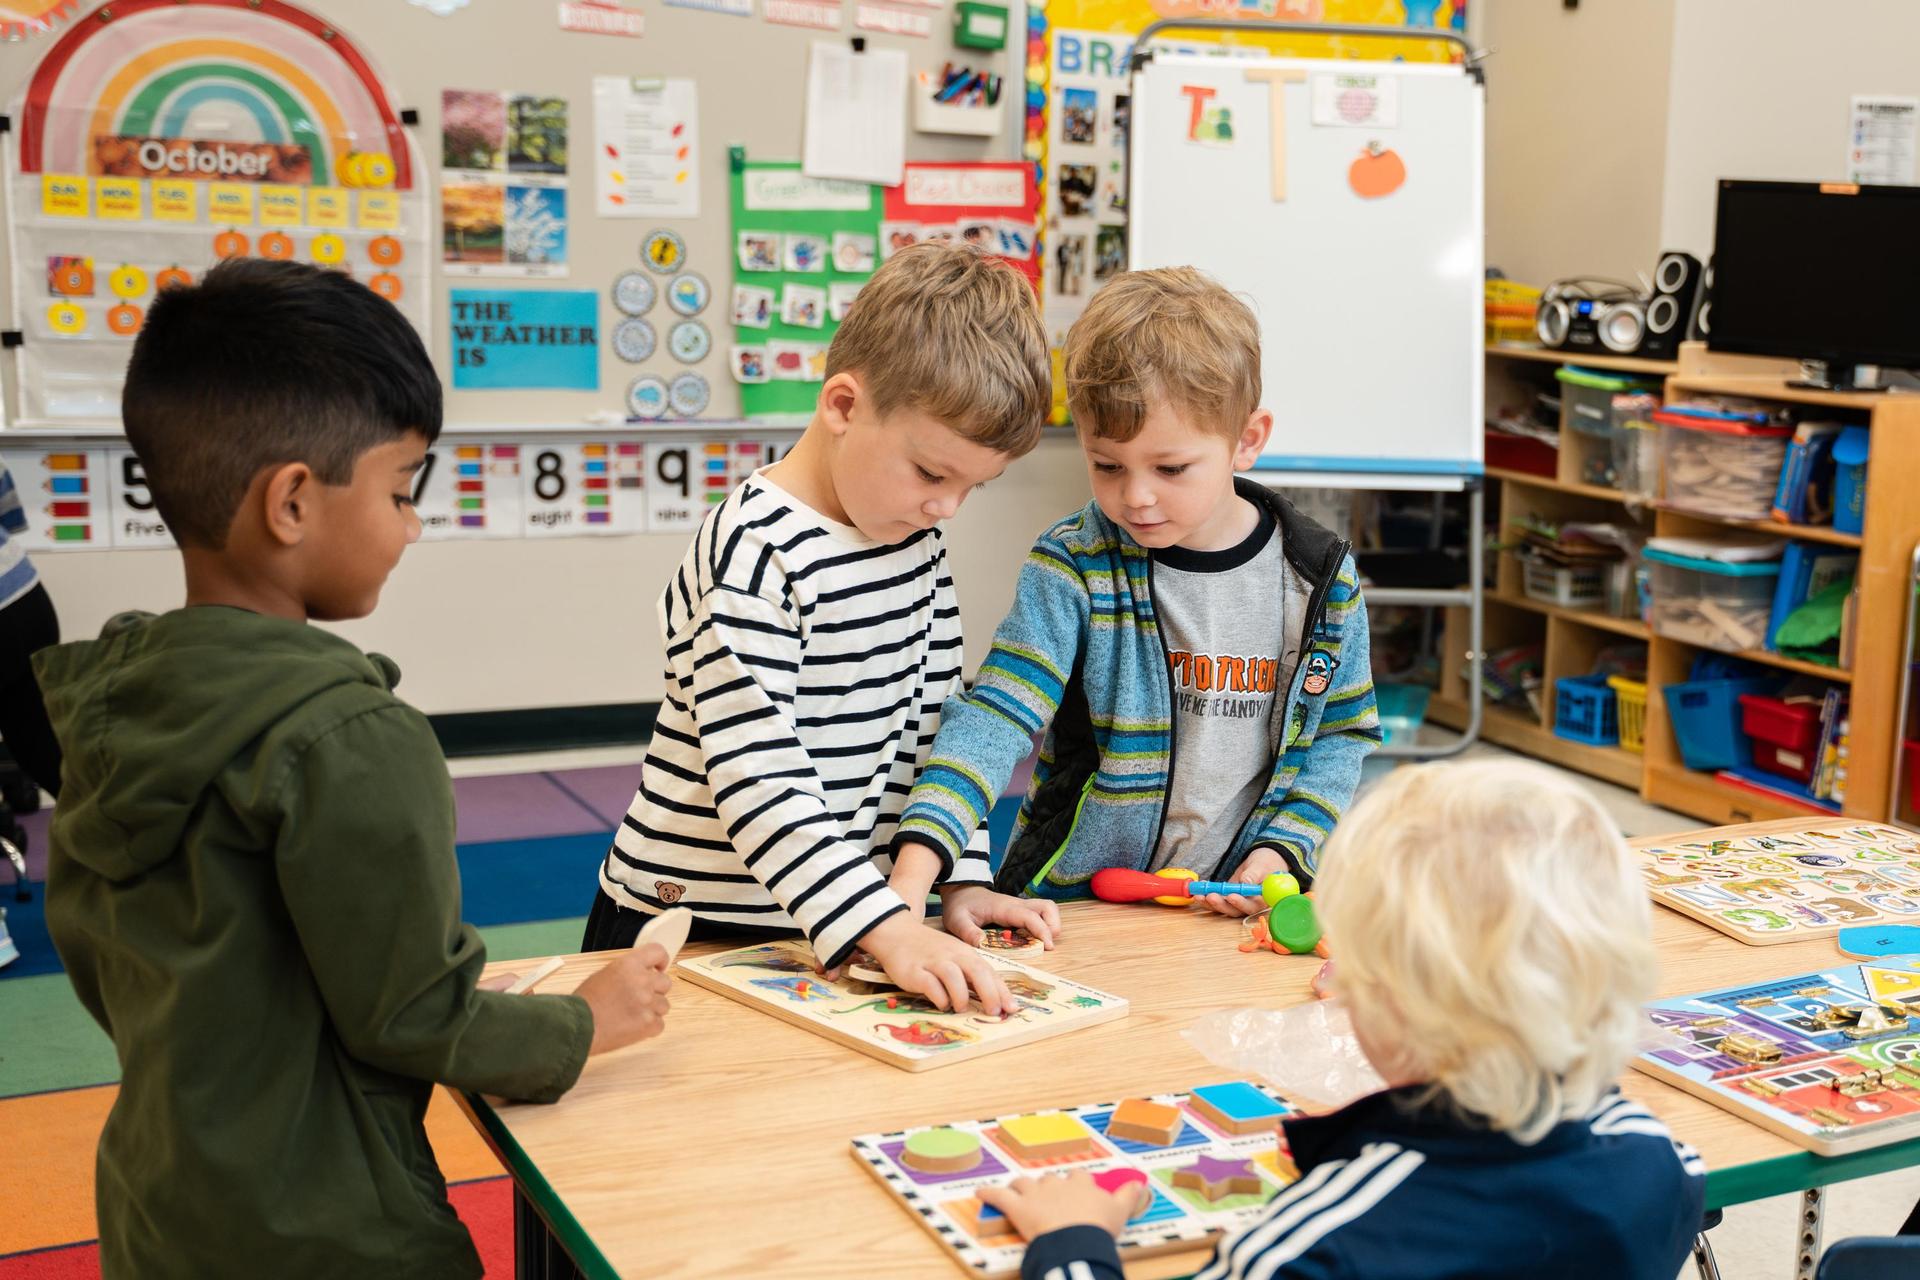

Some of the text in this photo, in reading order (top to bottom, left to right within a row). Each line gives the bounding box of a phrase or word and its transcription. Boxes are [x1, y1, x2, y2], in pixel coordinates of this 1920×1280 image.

[139, 140, 271, 175] October
[454, 302, 513, 320] THE
[454, 325, 598, 345] WEATHER
[459, 348, 486, 367] IS
[534, 451, 565, 501] 8
[657, 449, 688, 497] 9
[123, 457, 155, 510] 5
[530, 511, 572, 526] eight
[658, 510, 688, 519] nine
[126, 521, 166, 537] five
[1222, 699, 1266, 718] CANDY!
[1855, 1101, 1883, 1113] 4
[1231, 1136, 1275, 1147] RECTA
